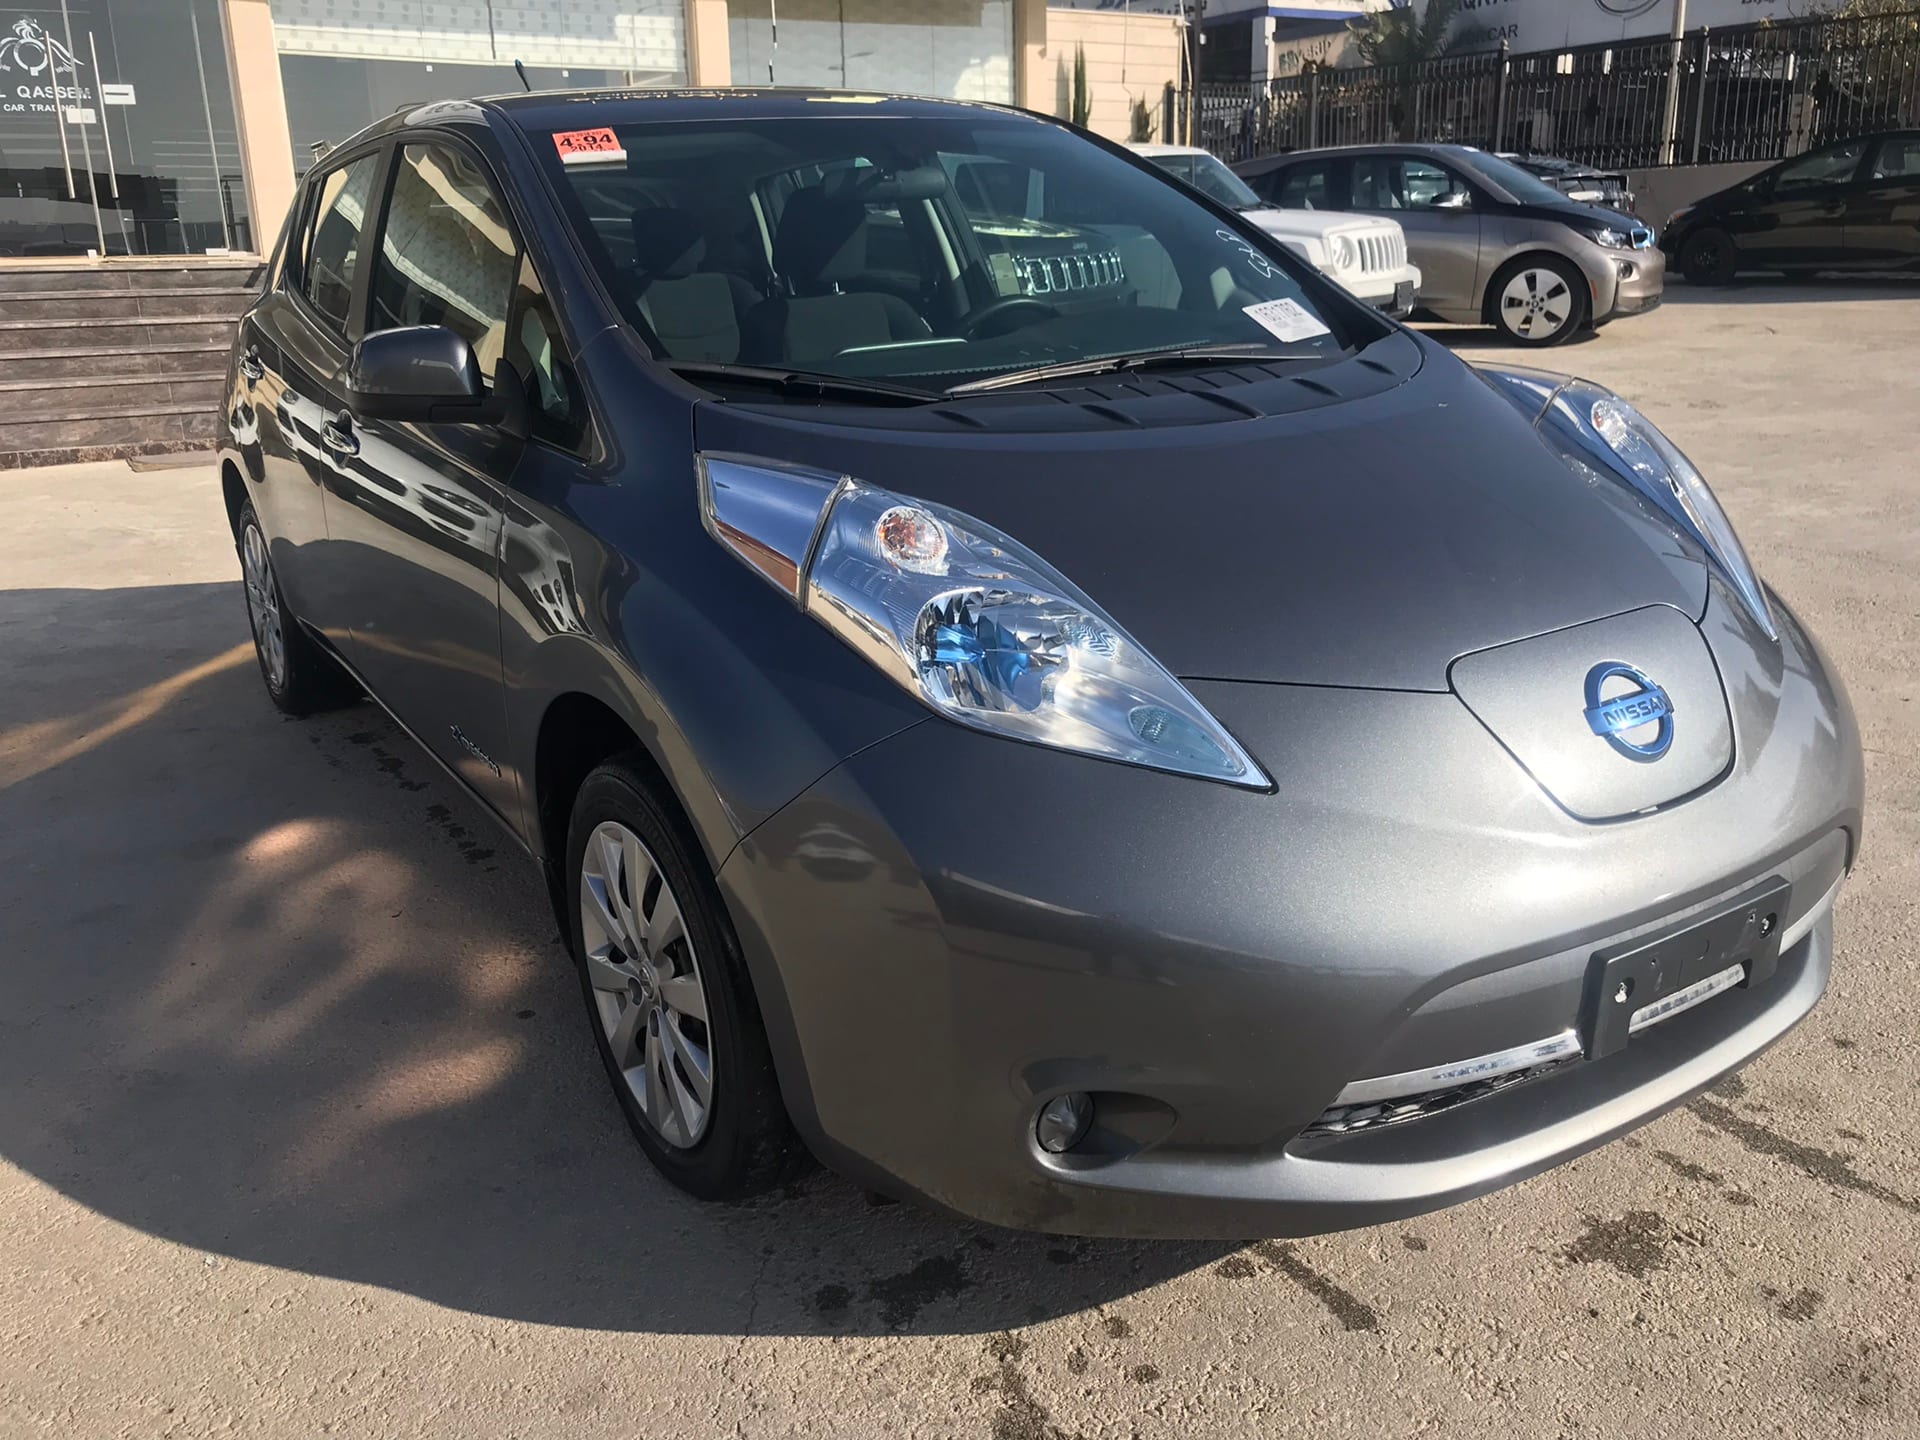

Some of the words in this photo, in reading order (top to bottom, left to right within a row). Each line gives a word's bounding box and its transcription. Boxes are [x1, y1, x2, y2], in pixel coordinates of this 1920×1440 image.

[1487, 24, 1518, 40] CAR
[3, 103, 25, 112] CAR
[560, 134, 612, 147] 4-94
[571, 143, 603, 152] 2014
[1603, 696, 1668, 726] NISSAN
